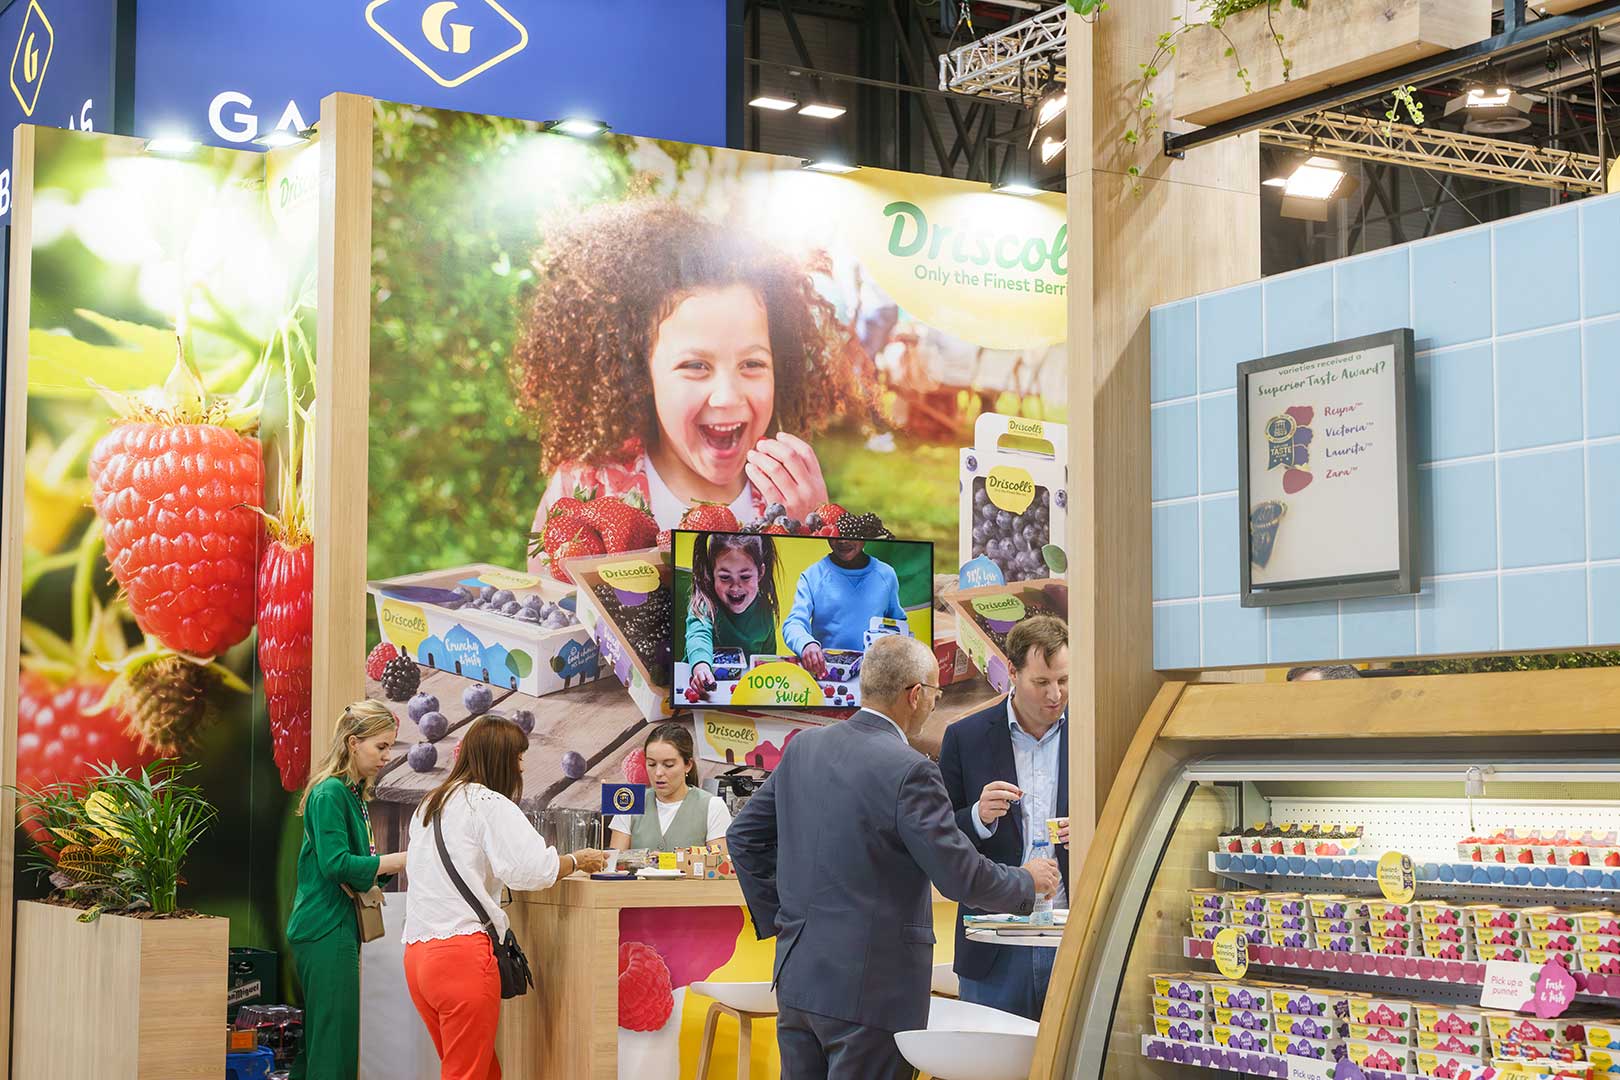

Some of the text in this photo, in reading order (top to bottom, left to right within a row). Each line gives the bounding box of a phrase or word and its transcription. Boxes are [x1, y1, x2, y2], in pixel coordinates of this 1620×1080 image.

[914, 264, 1068, 296] Only the Finest Berr
[1278, 353, 1362, 376] varieties received a
[1257, 360, 1387, 398] Superior Taste Award?
[1270, 446, 1292, 456] TASTE
[989, 475, 1033, 494] Driscoll's
[602, 561, 654, 578] Driscoll's
[383, 607, 426, 633] Driscoll's
[747, 674, 790, 690] 100%
[776, 687, 812, 706] sweet
[706, 721, 755, 742] Driscoll's
